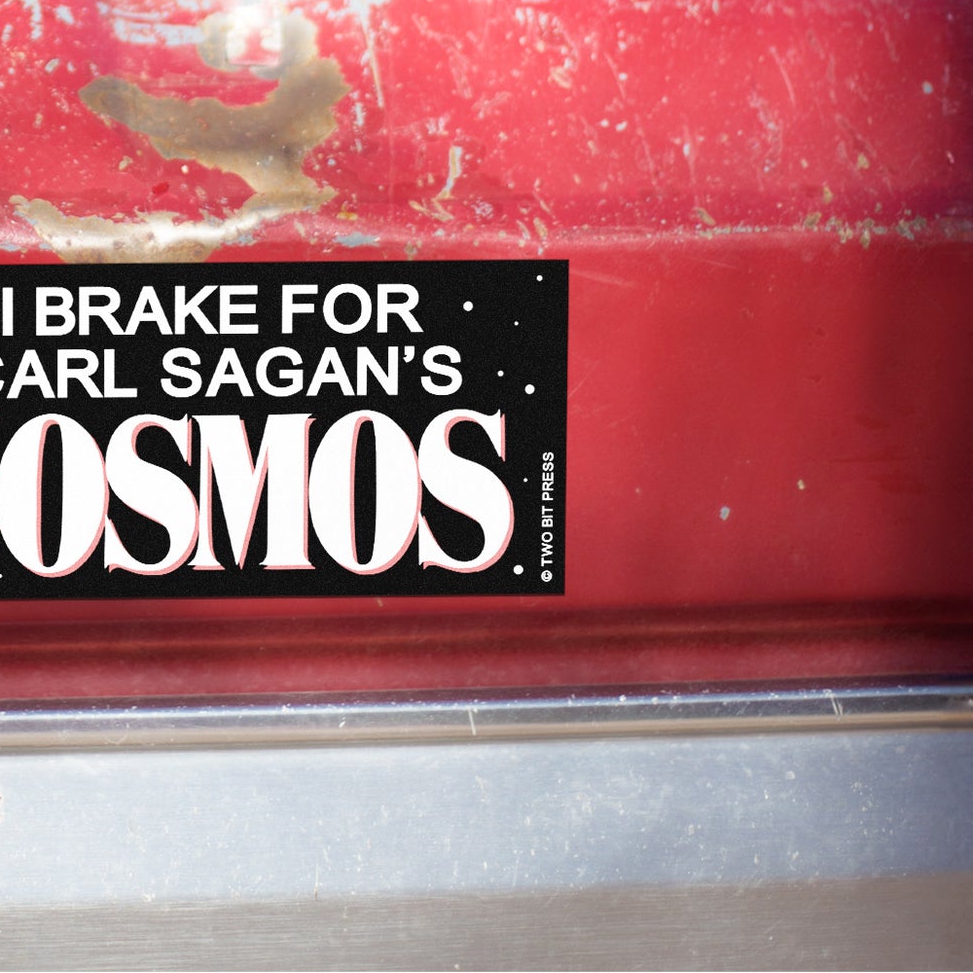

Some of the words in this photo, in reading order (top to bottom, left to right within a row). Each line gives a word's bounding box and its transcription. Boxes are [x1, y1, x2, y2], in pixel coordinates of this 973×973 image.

[2, 286, 14, 337] I
[35, 284, 259, 337] BRAKE
[281, 283, 424, 335] FOR
[160, 344, 463, 398] SAGAN’S
[541, 451, 555, 501] PRESS
[541, 505, 554, 528] BIT
[540, 531, 554, 567] TWO
